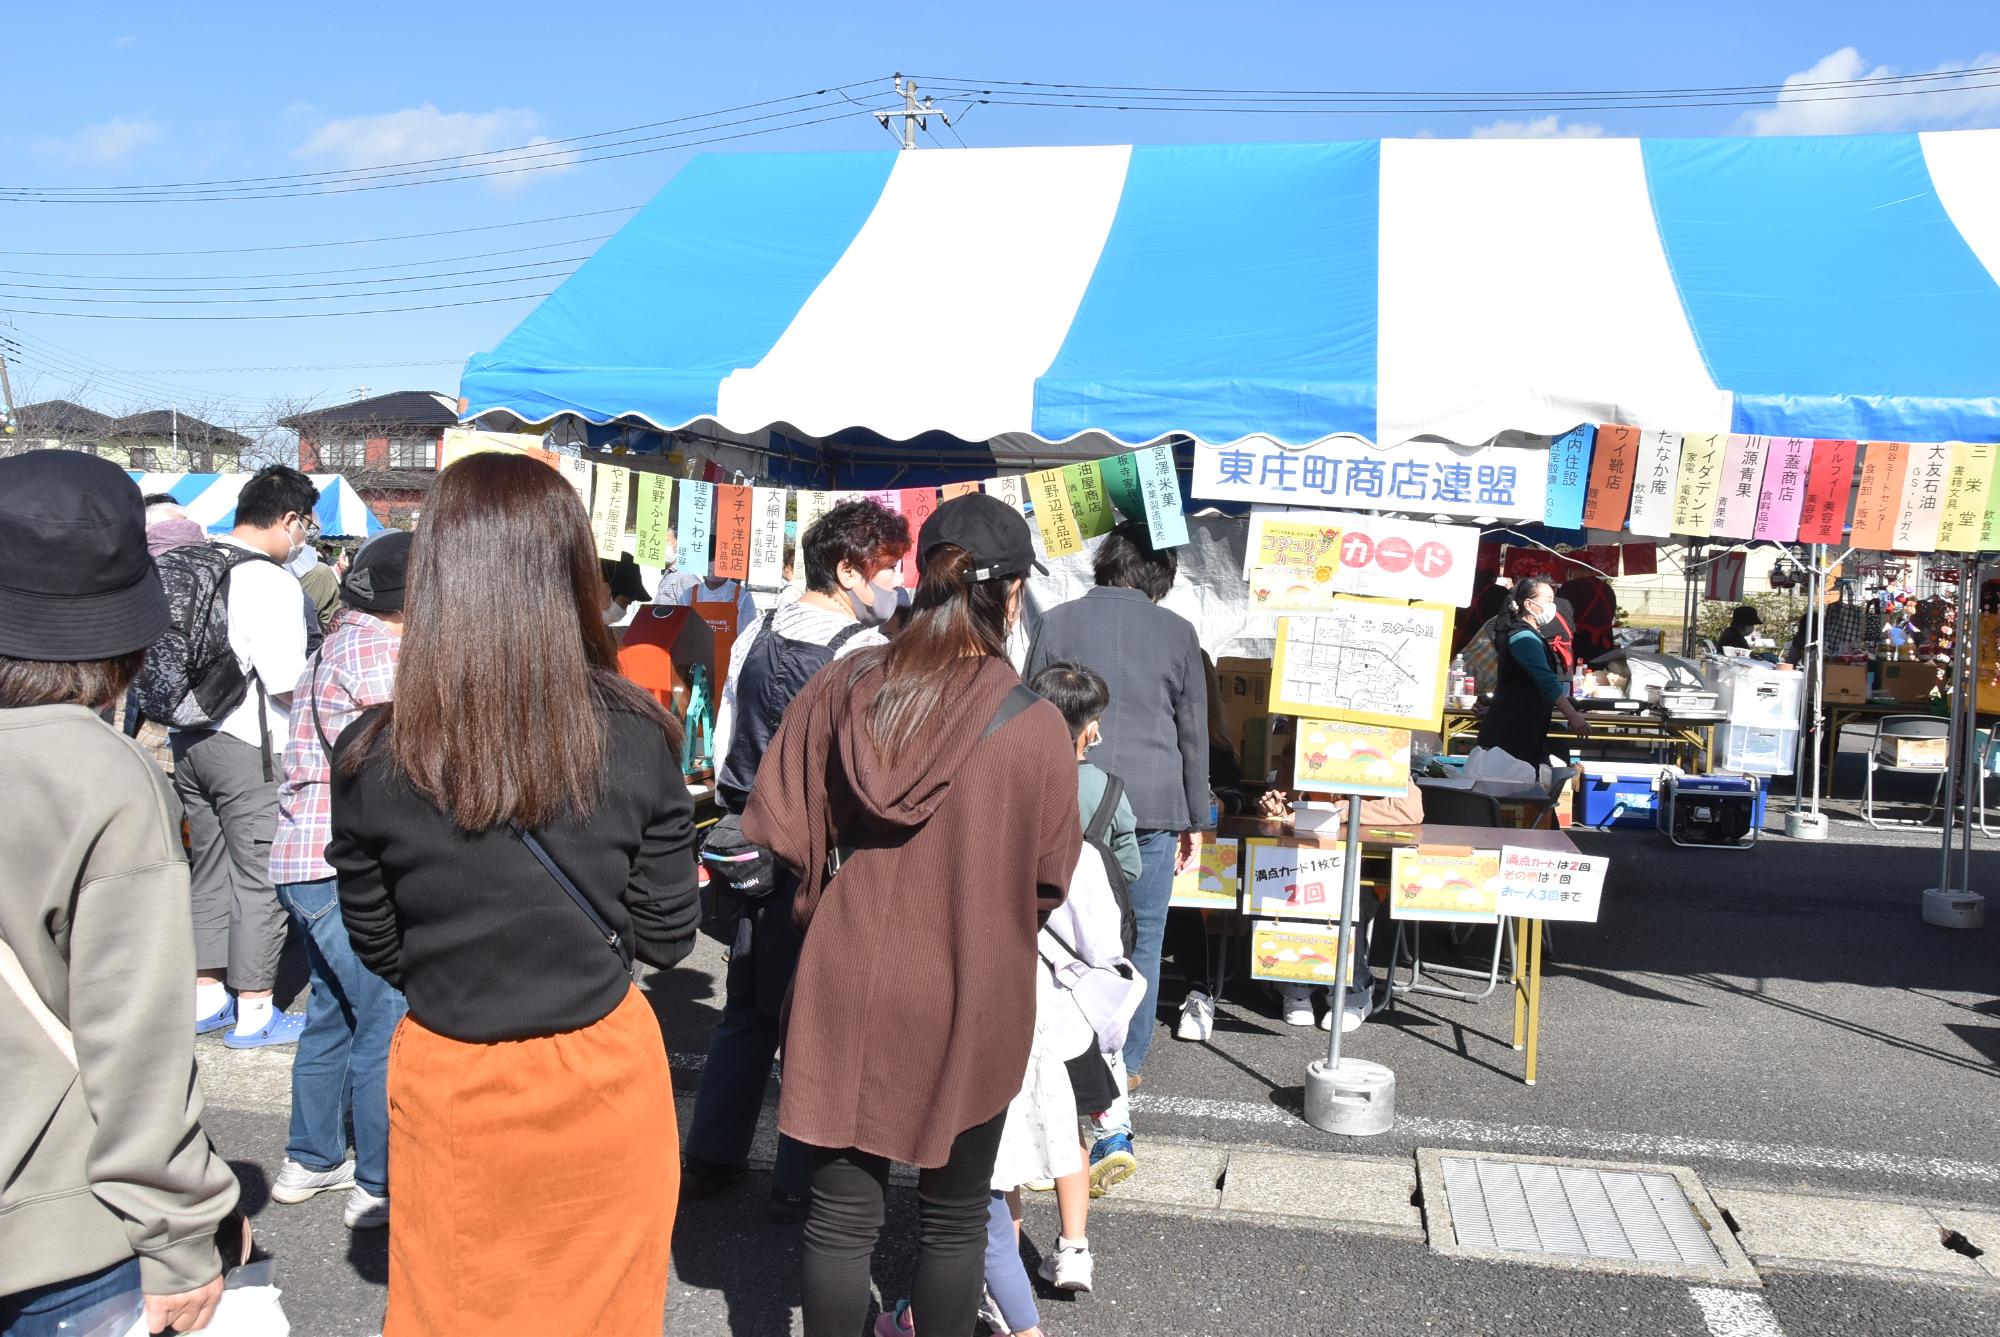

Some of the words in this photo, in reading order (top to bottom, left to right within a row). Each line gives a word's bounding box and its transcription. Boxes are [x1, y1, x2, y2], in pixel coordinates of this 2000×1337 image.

[1078, 461, 1102, 513] 油屋商店
[1215, 448, 1517, 506] 東庄町商店連盟
[1650, 429, 1673, 495] たなか庵
[1688, 433, 1718, 527] イイダデンキ
[1735, 435, 1761, 498] 川源青果
[1778, 437, 1805, 502] 竹蓋商店
[1818, 440, 1845, 537] アルフィー美容室
[1919, 445, 1946, 510] 大友石油
[1957, 445, 1988, 527] 三栄堂
[602, 467, 624, 553] やまだ屋酒店
[648, 474, 666, 561] 星野ふとん店
[691, 481, 708, 553] 理容こわせ
[730, 486, 745, 572] ツチヤ洋品店
[764, 489, 781, 563] 大網牛乳店
[1756, 490, 1774, 533] 食料品店
[718, 541, 729, 571] 洋品店
[1342, 538, 1446, 573] カード
[1704, 550, 1747, 602] 17
[1381, 622, 1433, 638] スタート!!
[1254, 856, 1342, 882] 満点カード1枚で
[1284, 882, 1327, 907] 2回
[1501, 886, 1583, 902] お一人3回まで
